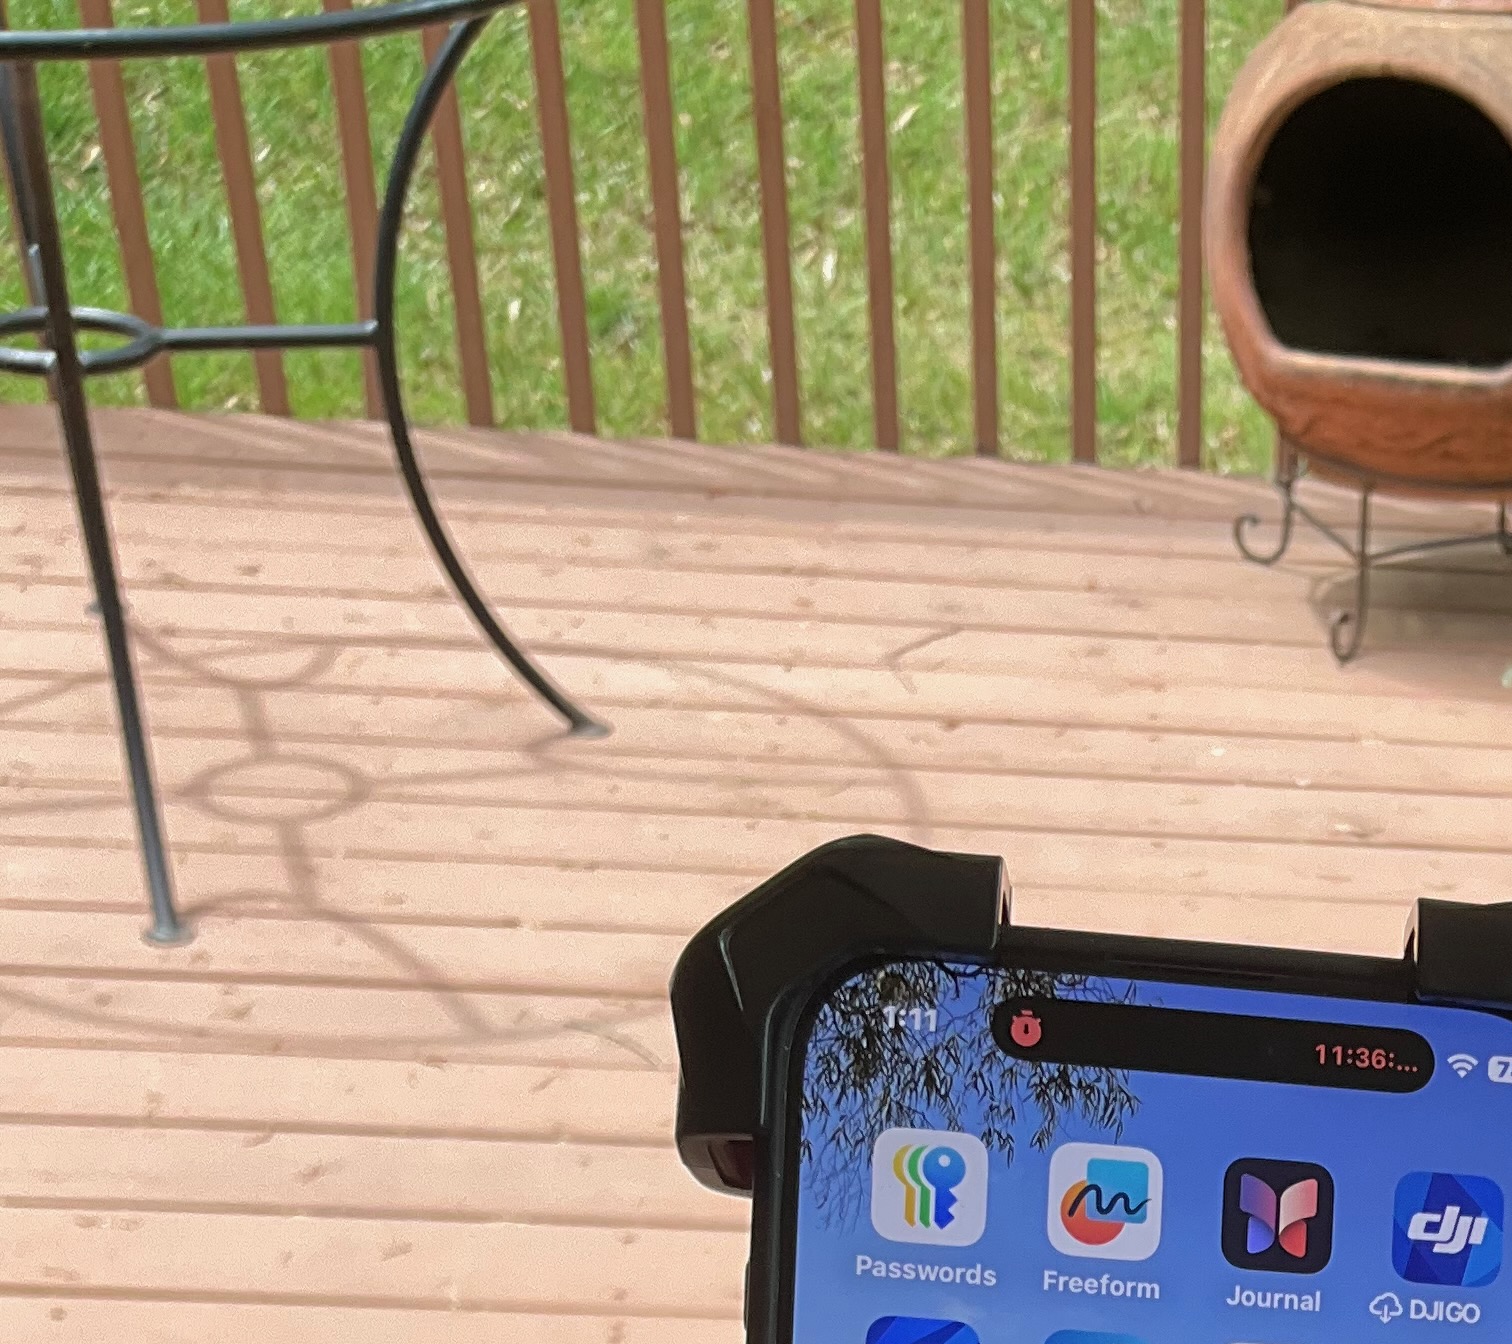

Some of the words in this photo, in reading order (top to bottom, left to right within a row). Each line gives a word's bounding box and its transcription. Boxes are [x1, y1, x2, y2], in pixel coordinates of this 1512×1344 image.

[883, 1005, 937, 1032] 1:11
[855, 1255, 998, 1287] Passwords
[1043, 1270, 1161, 1299] Freeform
[1226, 1285, 1321, 1312] Journal
